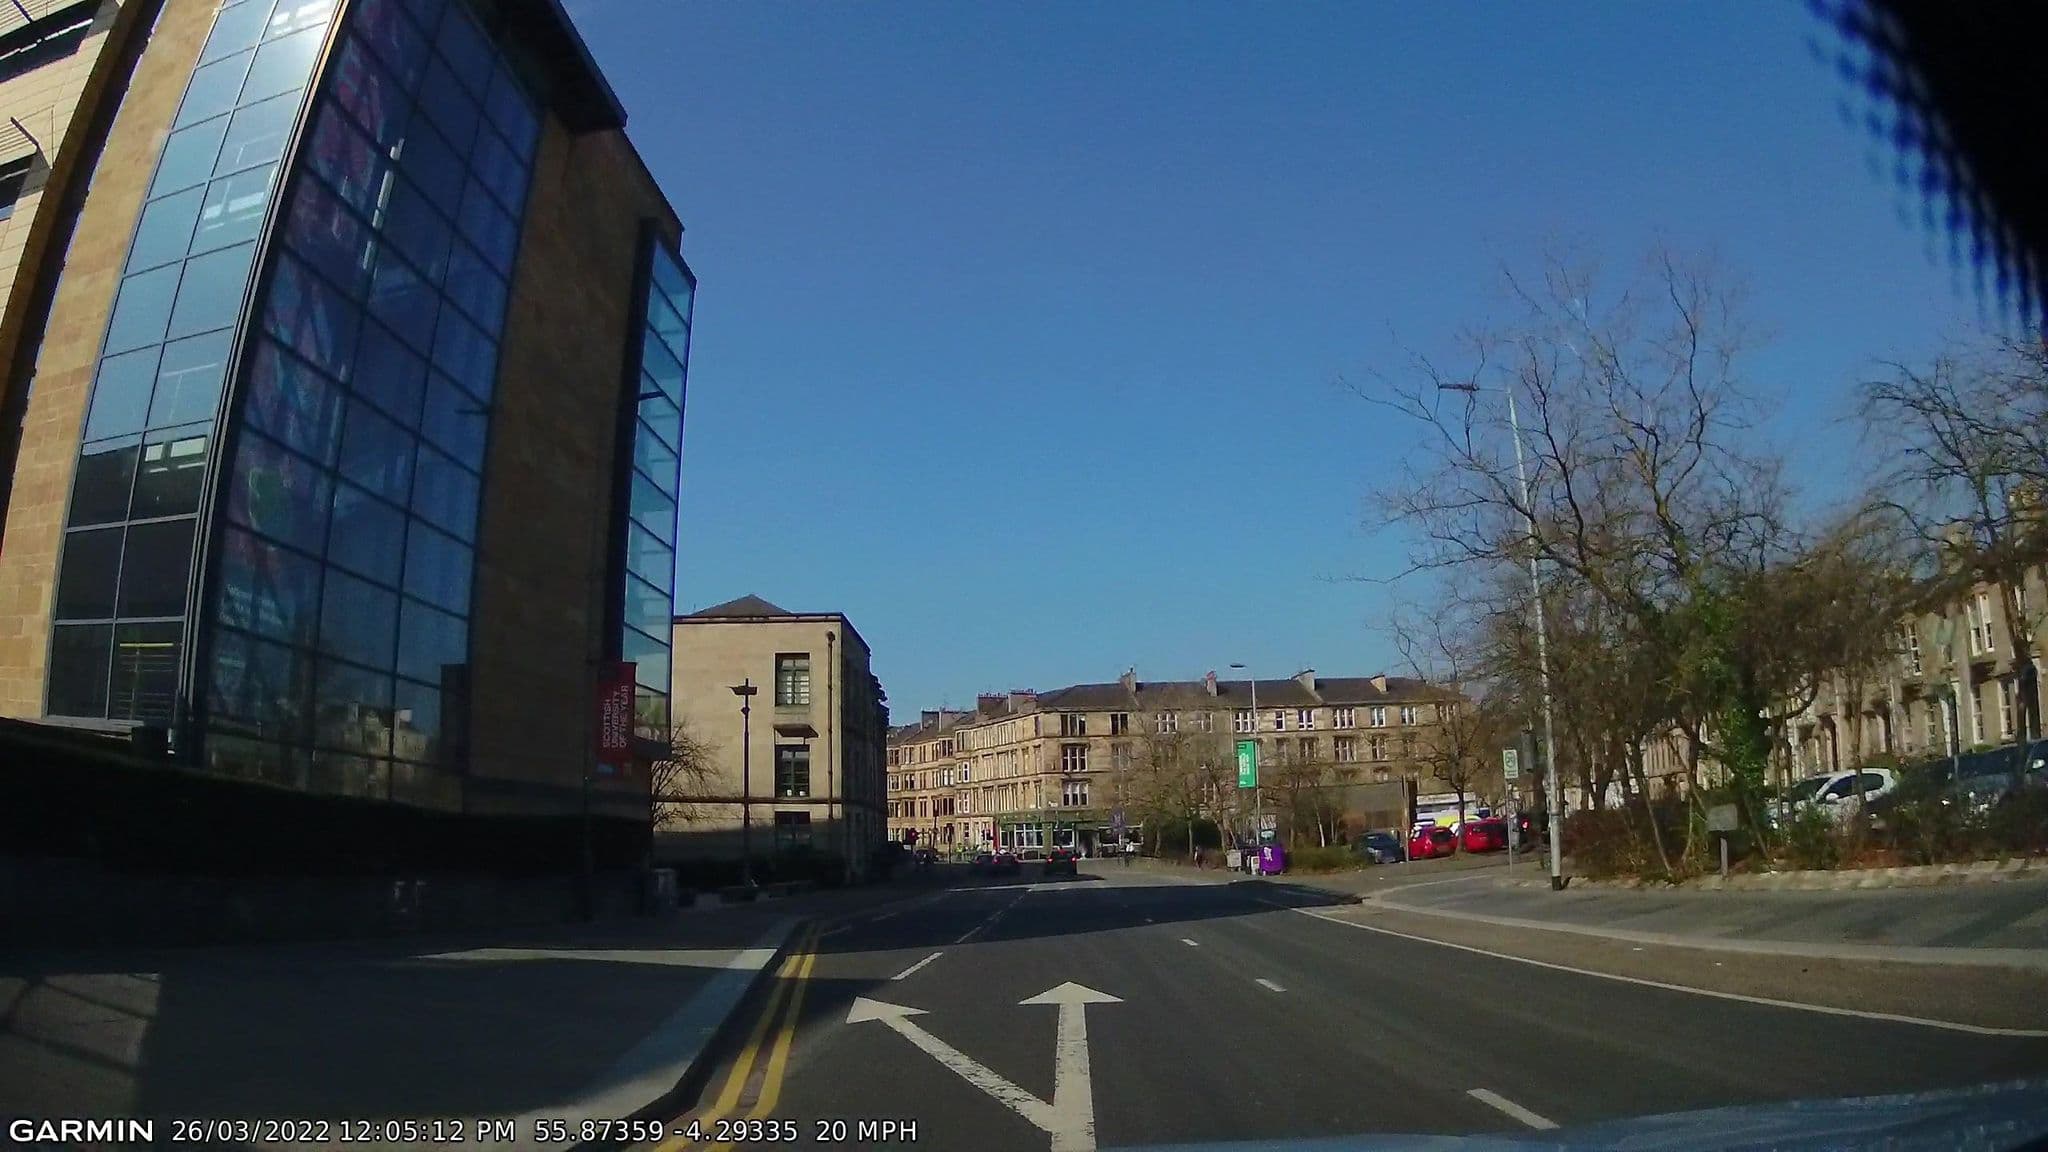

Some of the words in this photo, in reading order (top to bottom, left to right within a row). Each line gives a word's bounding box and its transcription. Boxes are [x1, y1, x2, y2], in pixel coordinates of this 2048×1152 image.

[620, 685, 629, 711] YEAR
[603, 699, 611, 748] SCOTTISH
[611, 690, 620, 748] UNIVERSITY
[620, 713, 628, 733] THE
[619, 736, 628, 748] OF
